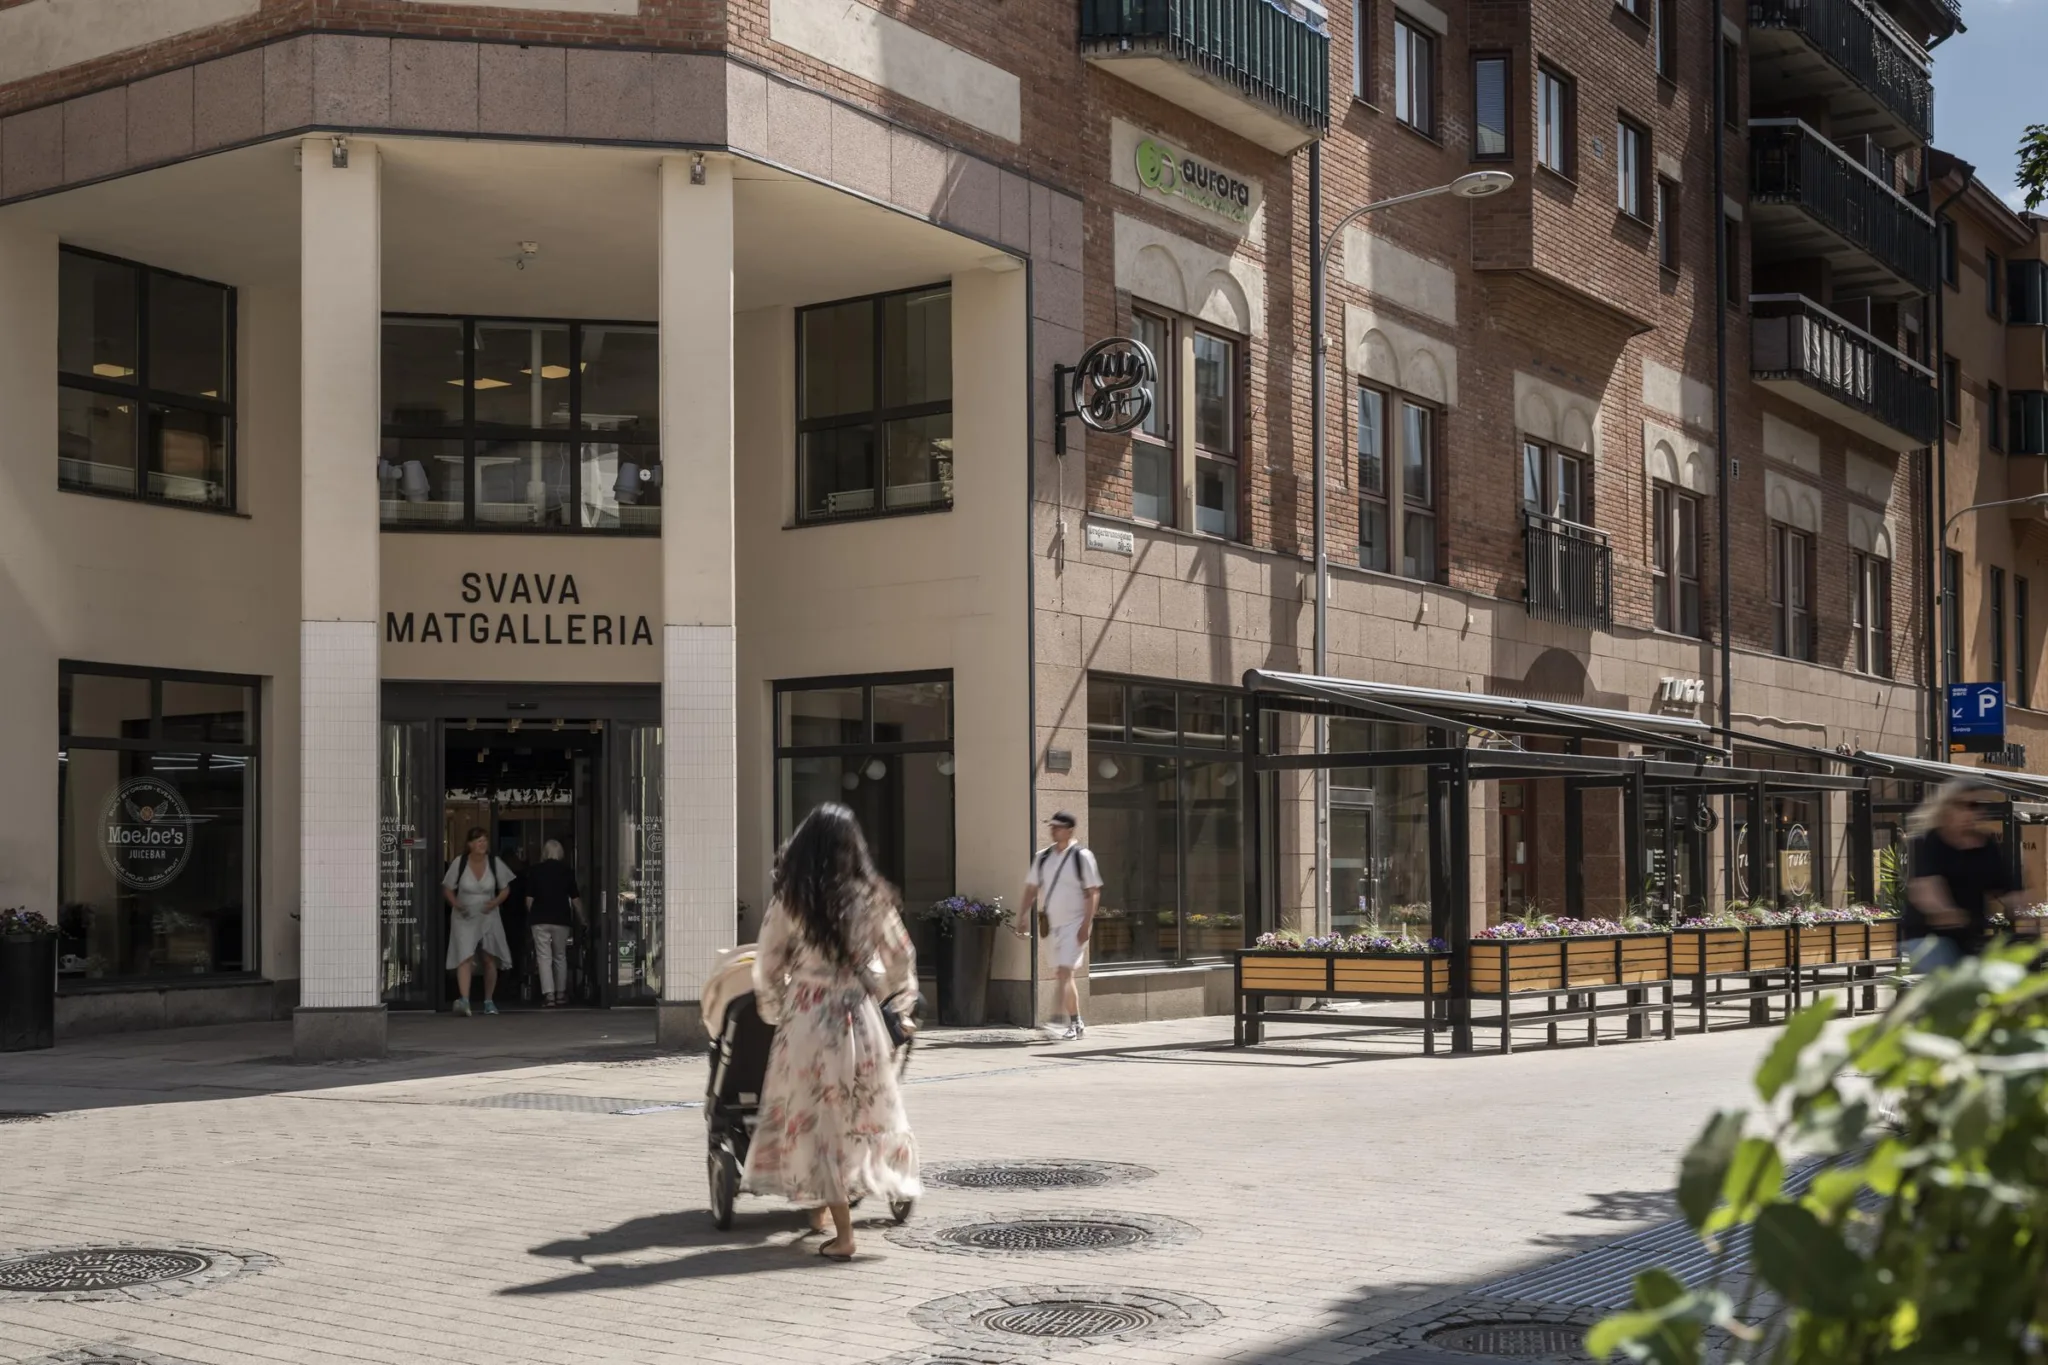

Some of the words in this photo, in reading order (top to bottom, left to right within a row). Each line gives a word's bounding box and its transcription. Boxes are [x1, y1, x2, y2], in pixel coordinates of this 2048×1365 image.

[1181, 158, 1249, 207] aurora
[461, 572, 580, 604] SVAVA
[386, 611, 653, 645] MATGALLERIA
[1660, 676, 1705, 704] TUGG
[1978, 694, 1997, 717] P
[380, 816, 400, 824] VAVA
[381, 824, 416, 832] ALLERIA
[108, 826, 184, 845] MoeJoe's
[128, 849, 166, 859] JUICEBAR
[125, 871, 144, 882] MOJO
[148, 873, 165, 882] REAL
